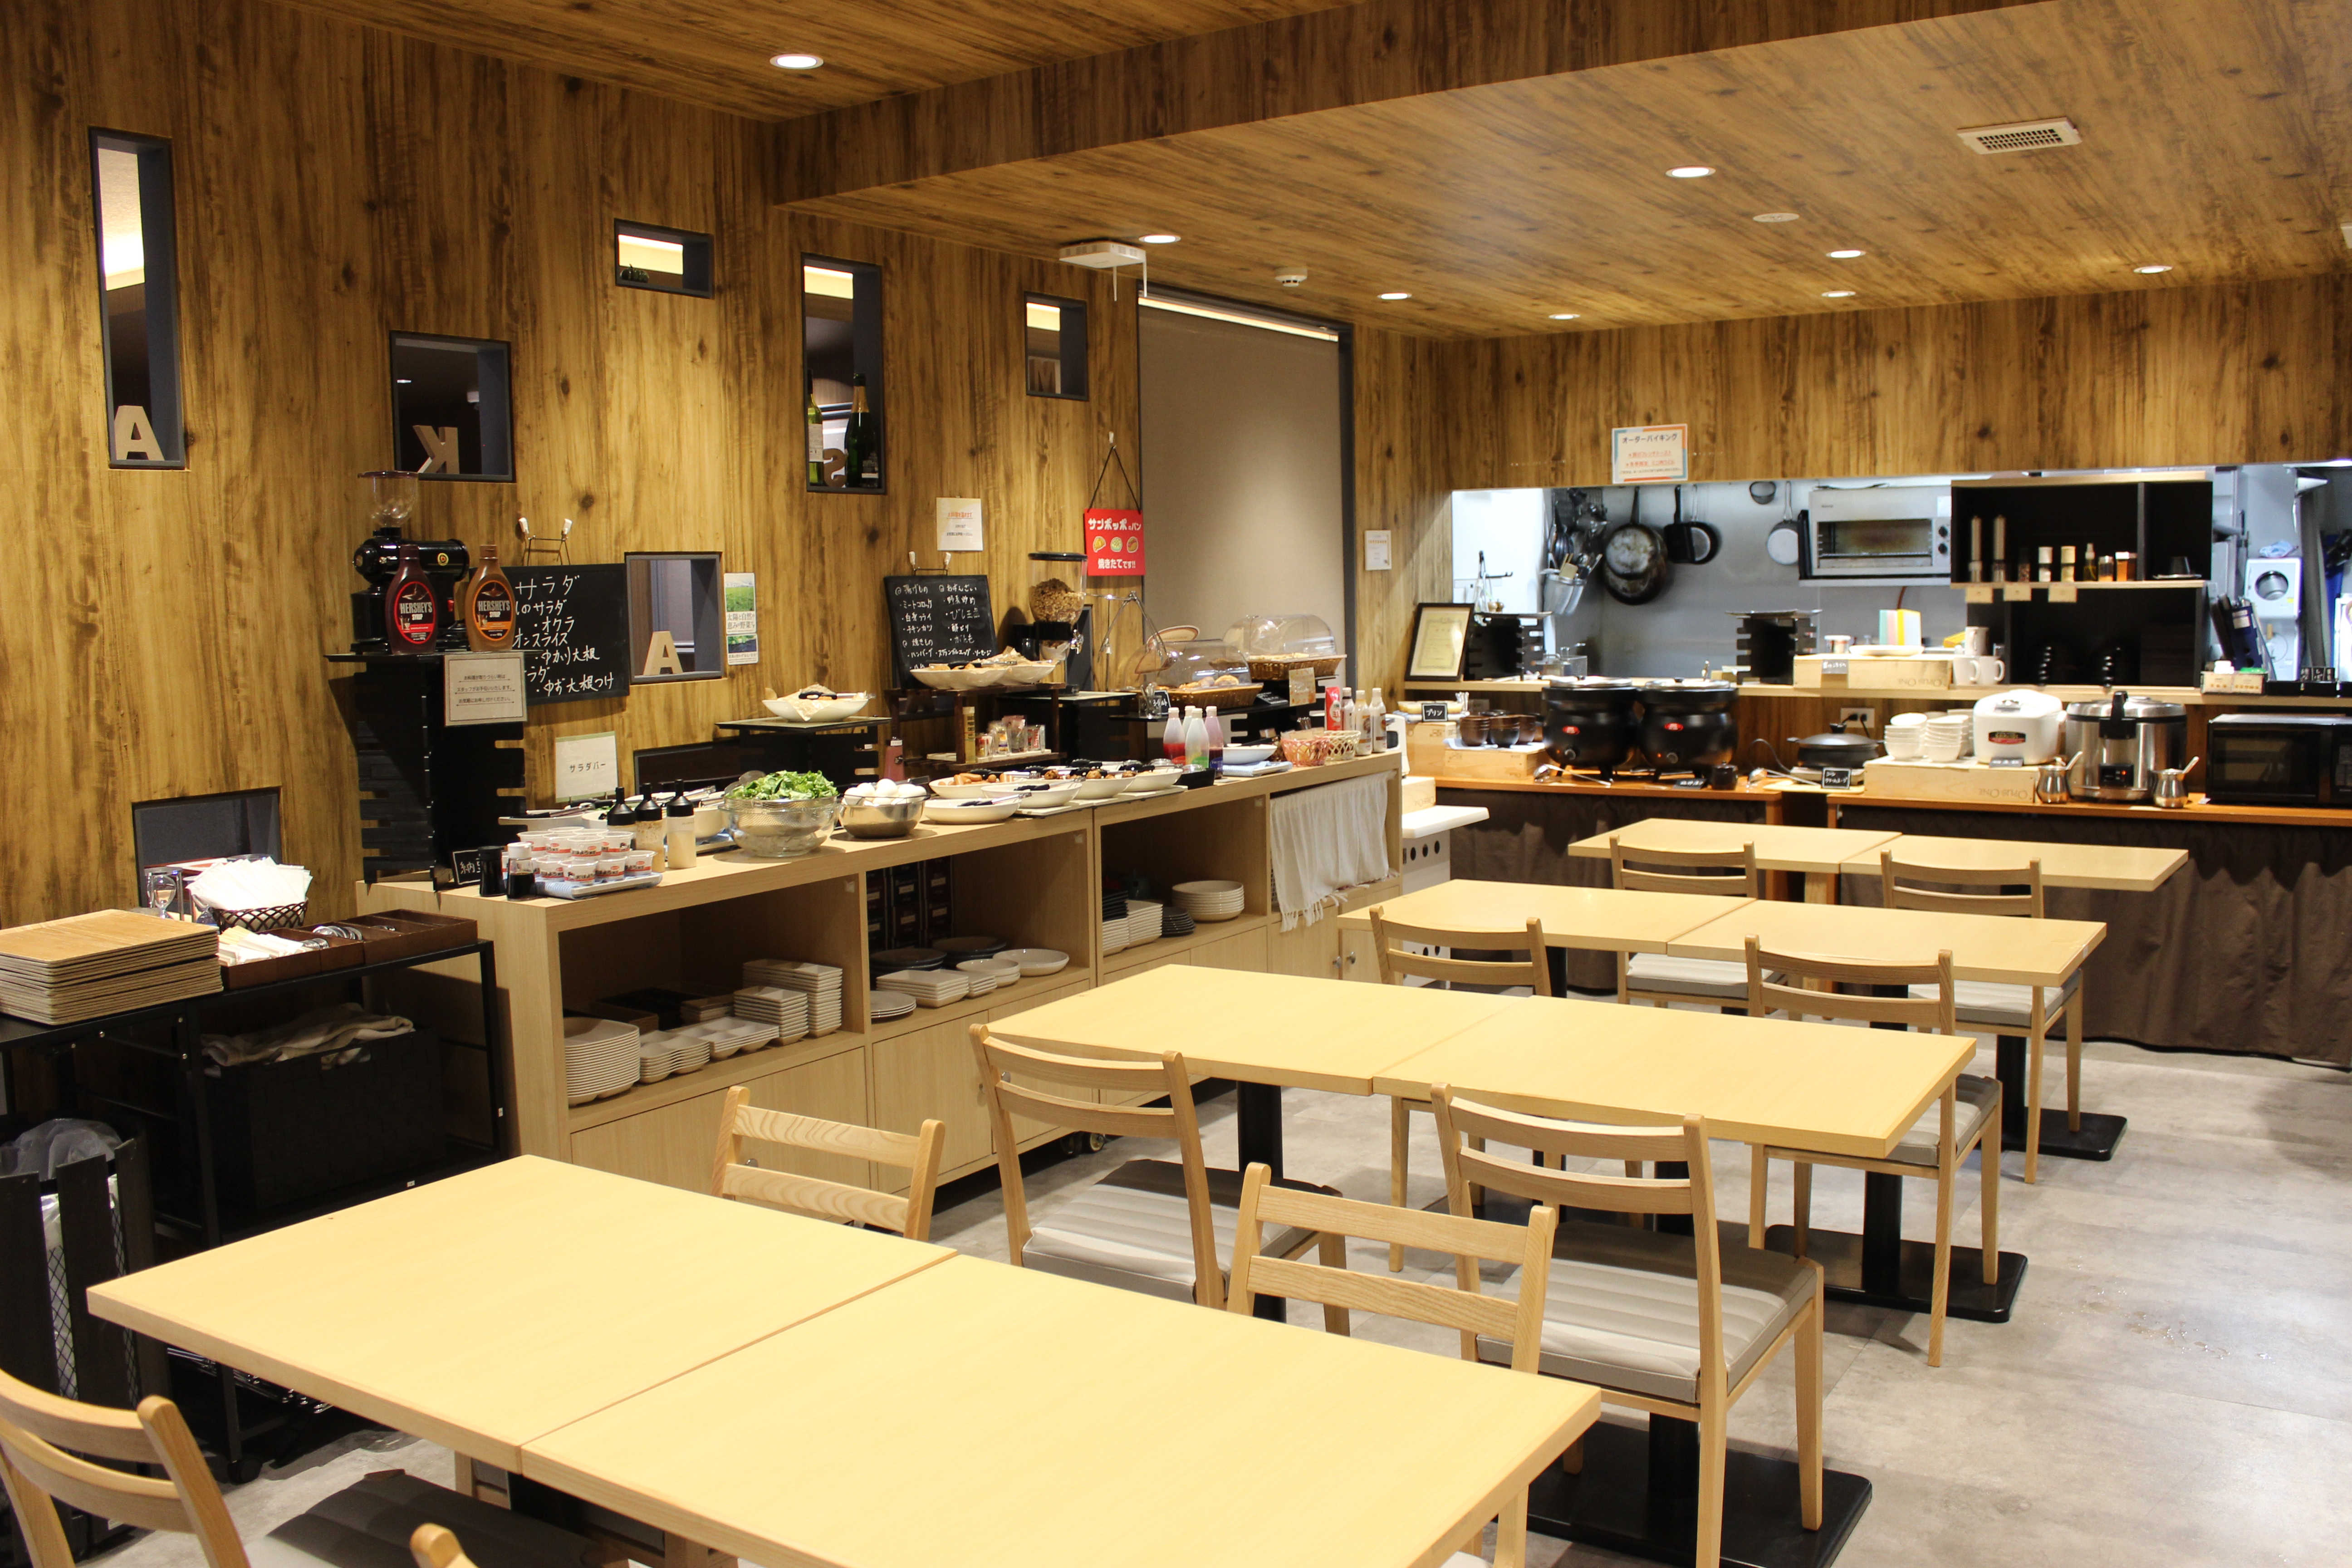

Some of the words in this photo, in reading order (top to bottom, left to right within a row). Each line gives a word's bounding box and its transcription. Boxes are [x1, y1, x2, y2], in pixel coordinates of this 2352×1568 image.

[114, 405, 165, 461] A
[1622, 433, 1678, 444] オーダーバイキング
[515, 575, 580, 600] サラダ
[400, 602, 433, 614] HERSHEY'S
[478, 600, 510, 612] HERSHEY'S
[643, 631, 683, 676] A
[1426, 708, 1443, 716] プリン
[569, 761, 606, 773] サラダバー
